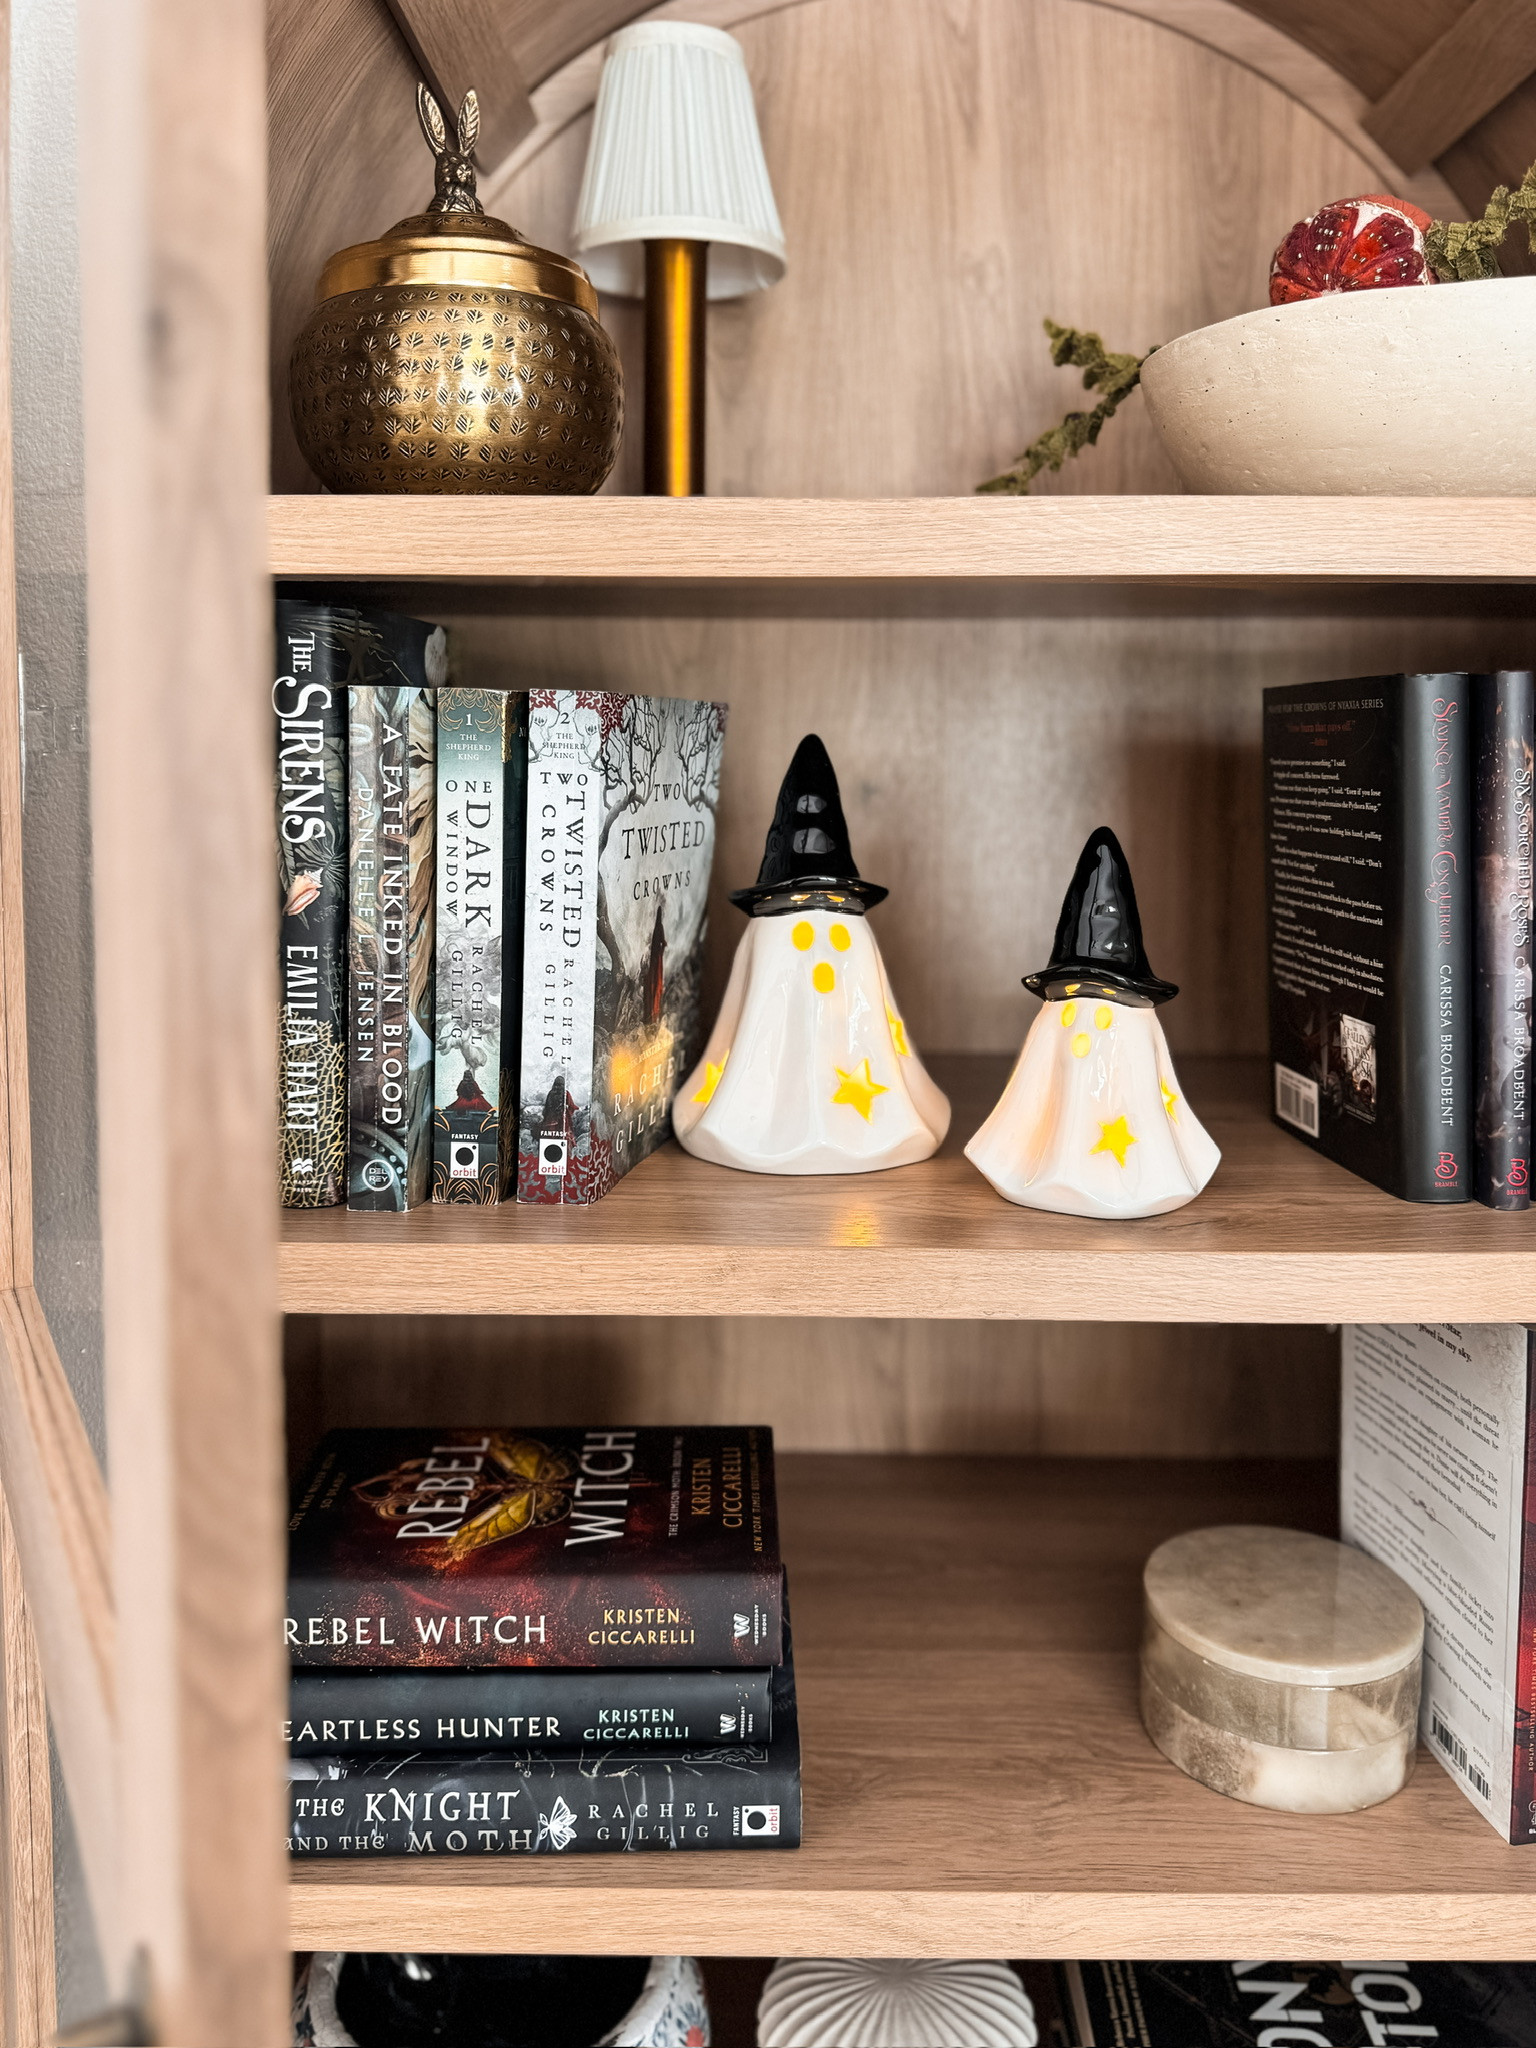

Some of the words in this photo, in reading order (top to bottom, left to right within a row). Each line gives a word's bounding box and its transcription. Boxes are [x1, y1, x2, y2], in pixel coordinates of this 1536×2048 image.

[288, 632, 315, 673] THE
[466, 714, 473, 726] 1
[560, 712, 570, 724] 2
[1338, 700, 1360, 710] NYAXIA
[1361, 698, 1384, 710] SERIES
[382, 723, 403, 744] A
[446, 743, 492, 752] SHEPHERD
[542, 741, 586, 750] SHEPHERD
[556, 732, 574, 740] THE
[1430, 698, 1458, 772] SLAYING
[272, 676, 332, 844] SIRENS
[554, 752, 575, 760] KING
[446, 780, 492, 794] ONE
[540, 772, 588, 786] TWO
[654, 782, 680, 802] TWO
[1513, 768, 1532, 797] SIX
[383, 765, 403, 836] FATE
[358, 788, 374, 917] DANIELLE
[622, 820, 706, 860] TWISTED
[1513, 800, 1531, 889] SCORCHED
[446, 810, 458, 916] WINDOW
[465, 800, 492, 928] DARK
[540, 804, 556, 932] CROWNS
[562, 791, 586, 948] TWISTED
[633, 870, 692, 901] CROWNS
[1424, 850, 1458, 948] CONQUEROR
[383, 856, 403, 955] INKED
[1509, 892, 1530, 947] ROSES
[358, 934, 374, 952] L.
[287, 946, 318, 1046] EMILIA
[382, 974, 403, 1002] IN
[451, 951, 464, 1039] GILLIG
[471, 946, 484, 1044] RACHEL
[1439, 964, 1452, 1028] CARISSA
[1513, 956, 1526, 1020] CARISSA
[355, 970, 374, 1062] JENSEN
[543, 964, 556, 1058] GILLIG
[562, 958, 574, 1065] RACHEL
[381, 1024, 403, 1125] BLOOD
[614, 1050, 686, 1116] RACHEL
[1440, 1034, 1453, 1126] BROADBENT
[1513, 1028, 1526, 1120] BROADBENT
[287, 1062, 318, 1134] HART
[616, 1098, 668, 1154] GILLI
[452, 1166, 477, 1177] orbit
[541, 1164, 565, 1174] orbit
[1418, 1323, 1436, 1339] jewel
[1437, 1332, 1444, 1344] in
[1446, 1340, 1457, 1354] my
[1458, 1348, 1472, 1362] sky.
[1472, 1404, 1500, 1427] personally
[396, 1437, 490, 1539] REBEL
[564, 1432, 637, 1548] WITCH
[691, 1458, 712, 1516] KRISTEN
[722, 1446, 743, 1528] CICCARELLI
[1487, 1470, 1498, 1484] The
[670, 1490, 680, 1522] CRIMSON
[669, 1523, 678, 1537] THE
[754, 1536, 762, 1552] NEW
[283, 1616, 396, 1646] REBEL
[414, 1615, 546, 1644] WITCH
[603, 1608, 680, 1626] KRISTEN
[588, 1630, 694, 1645] CICCARELLI
[281, 1719, 421, 1742] EARTLESS
[437, 1716, 561, 1738] HUNTER
[583, 1726, 689, 1740] CICCARELLI
[598, 1708, 675, 1724] KRISTEN
[296, 1798, 345, 1817] THE
[364, 1788, 520, 1822] KNIGHT
[588, 1802, 719, 1819] RACHEL
[732, 1806, 740, 1836] FANTASY
[768, 1808, 778, 1833] orbit
[338, 1836, 386, 1850] THE
[406, 1830, 533, 1852] MOTH
[596, 1825, 710, 1840] GILLIG
